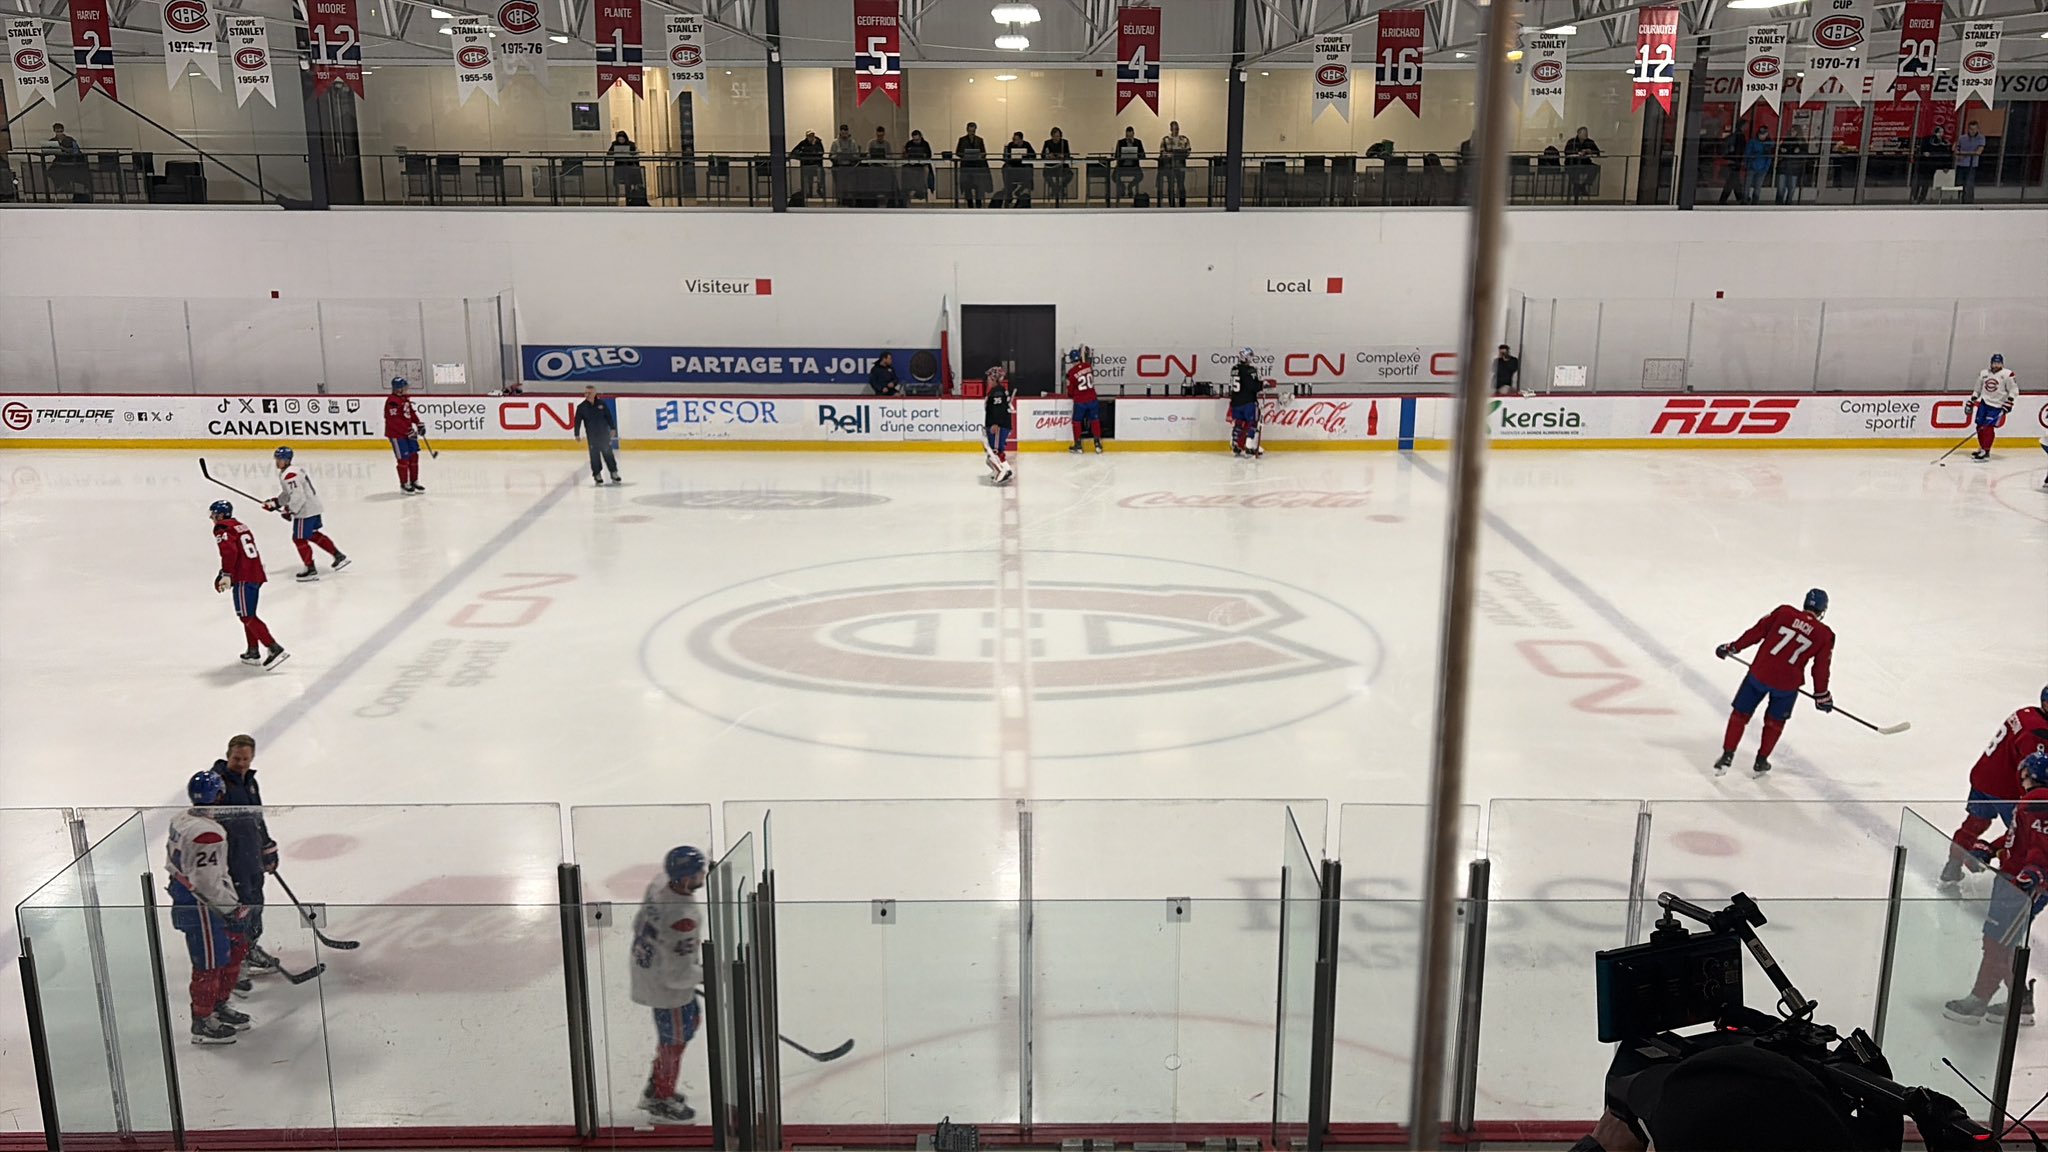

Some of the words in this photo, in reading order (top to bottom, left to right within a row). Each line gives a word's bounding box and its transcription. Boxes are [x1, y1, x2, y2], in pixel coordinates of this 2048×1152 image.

[317, 3, 347, 14] MOORE
[1833, 0, 1852, 10] CUP
[77, 10, 100, 20] HARVEY
[604, 8, 632, 18] PLANTE
[14, 20, 35, 28] COUPE
[236, 20, 256, 28] COUPE
[458, 18, 479, 26] COUPE
[674, 17, 695, 25] COUPE
[857, 16, 896, 26] GEOFFRION
[1909, 19, 1935, 29] DRYDEN
[8, 27, 42, 38] STANLEY
[229, 27, 265, 37] STANLEY
[452, 26, 488, 35] STANLEY
[667, 24, 703, 33] STANLEY
[1382, 27, 1420, 37] H.RICHARD
[1639, 24, 1677, 35] COURNOYER
[1757, 28, 1778, 36] COUPE
[242, 37, 255, 45] CUP
[1323, 36, 1344, 44] COUPE
[1748, 36, 1785, 45] STANLEY
[1965, 31, 2000, 40] STANLEY
[83, 31, 103, 69] 2
[168, 41, 213, 53] 1976-77
[312, 25, 356, 65] 12
[501, 43, 543, 55] 1975-76
[612, 28, 628, 67] 1
[1316, 43, 1351, 53] STANLEY
[1531, 40, 1566, 50] STANLEY
[868, 37, 887, 76] 5
[1899, 39, 1936, 77] 29
[1128, 45, 1149, 83] 4
[1382, 47, 1422, 86] 16
[1639, 44, 1673, 82] 12
[1810, 58, 1860, 69] 1970-71
[460, 73, 493, 83] 1955-56
[672, 72, 704, 80] 1952-53
[1746, 82, 1778, 92] 1930-31
[1961, 78, 1993, 87] 1929-30
[1316, 91, 1348, 99] 1945-46
[1531, 88, 1562, 96] 1943-44
[685, 279, 750, 294] Visiteur
[1267, 279, 1312, 293] Local
[537, 346, 641, 378] OREO
[671, 356, 783, 374] PARTAGE
[788, 357, 819, 374] TA
[1210, 353, 1276, 365] Comexe
[1285, 353, 1345, 376] CN
[1356, 352, 1421, 367] Complexe
[1137, 354, 1197, 377] CN
[1378, 364, 1419, 379] sportif
[36, 409, 115, 419] TRICOLORE
[683, 400, 779, 424] ESSOR
[878, 406, 907, 419] Tout
[911, 407, 940, 421] part
[1840, 400, 1921, 416] Complexe
[498, 402, 575, 430] CN
[818, 404, 871, 434] Bell
[1501, 407, 1581, 428] kersia
[1650, 399, 1800, 434] RDS
[208, 420, 375, 436] CANADIENSMTL
[434, 417, 485, 433] sportif
[880, 420, 914, 433] d'une
[1036, 416, 1073, 429] CANAD
[1865, 415, 1918, 432] sportif
[240, 534, 258, 559] 6
[1792, 618, 1815, 636] DACH
[1769, 625, 1813, 665] 77
[196, 851, 219, 868] 24
